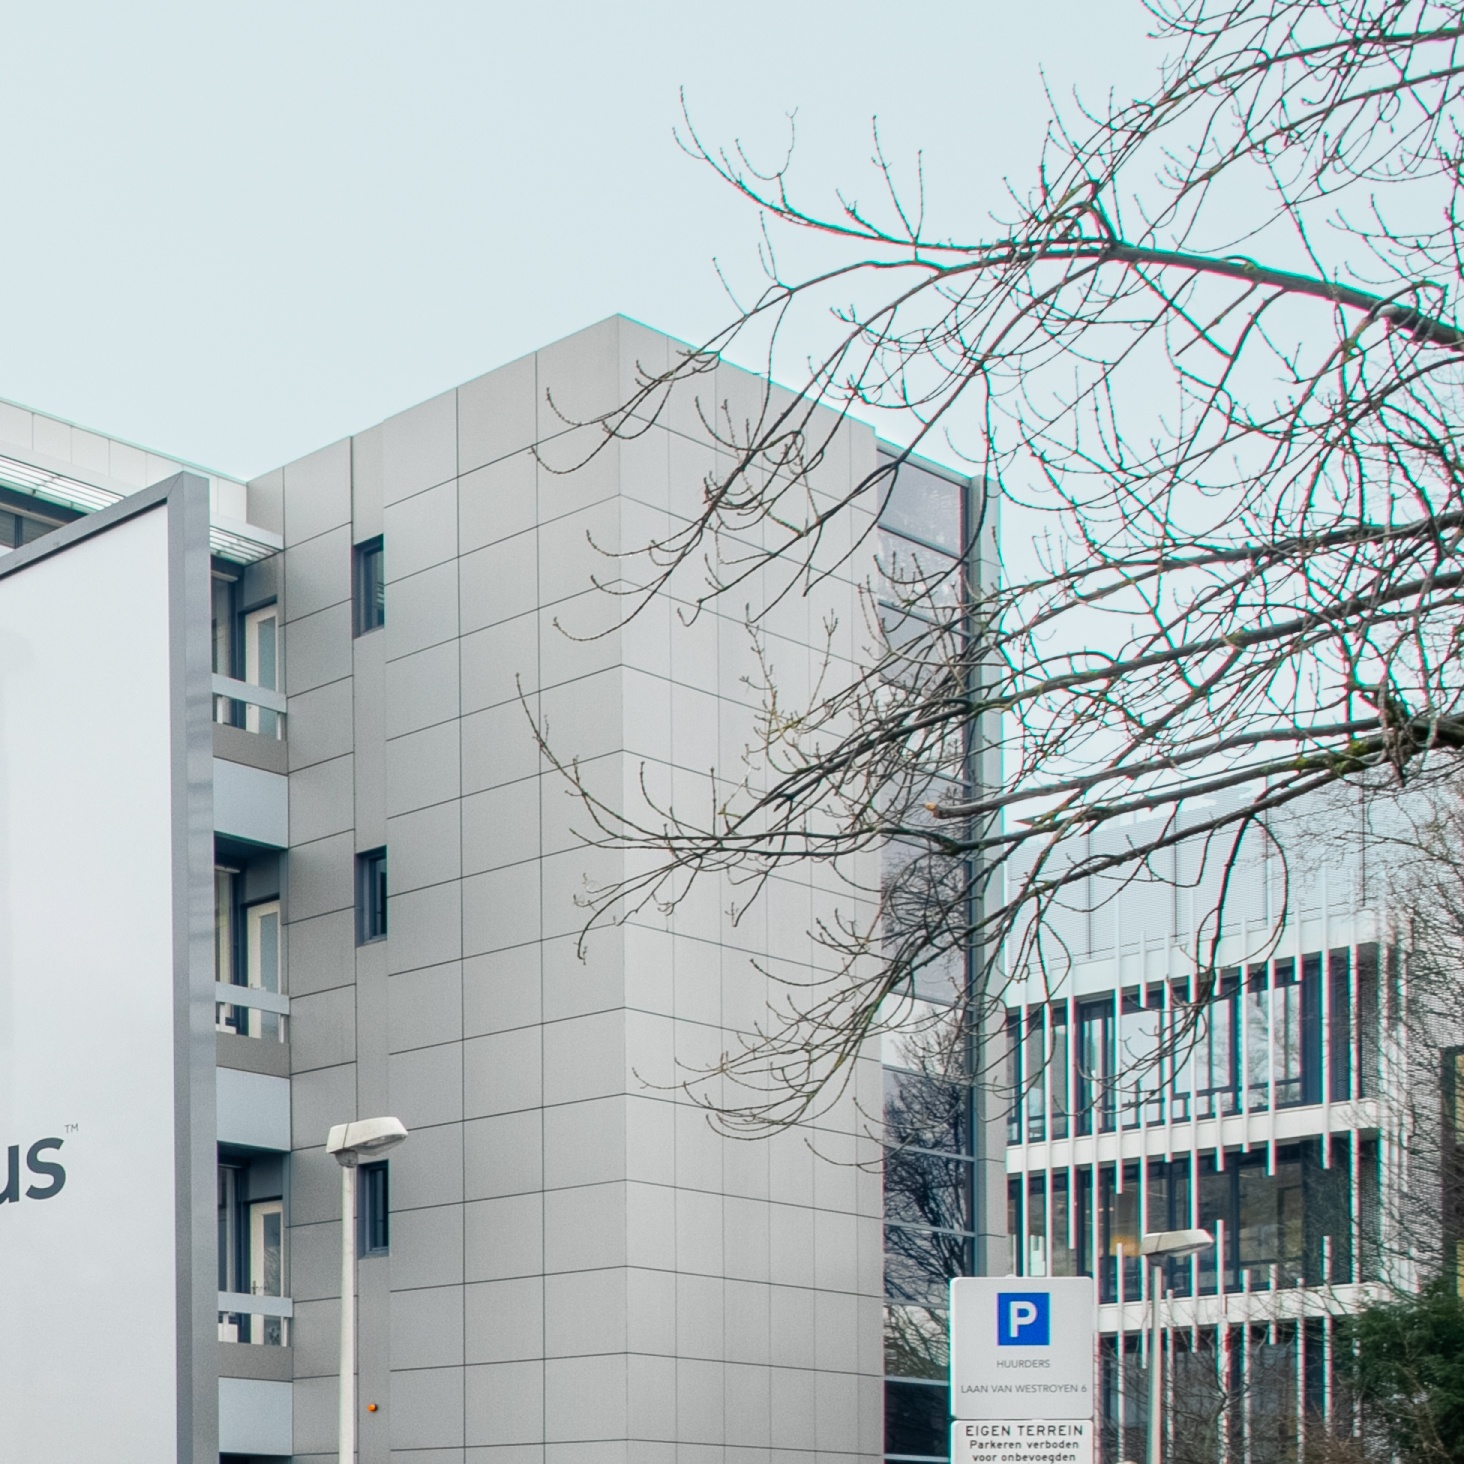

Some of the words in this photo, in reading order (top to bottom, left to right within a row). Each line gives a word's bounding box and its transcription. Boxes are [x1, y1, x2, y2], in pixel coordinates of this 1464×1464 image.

[1009, 1300, 1038, 1338] P
[996, 1359, 1051, 1369] HUURDERS
[960, 1385, 989, 1394] LAAN
[991, 1385, 1013, 1393] VAN
[1015, 1384, 1078, 1393] WESTROYEN
[1080, 1384, 1088, 1393] 6
[965, 1425, 1011, 1437] EIGEN
[1017, 1425, 1084, 1436] TERREIN
[969, 1440, 1022, 1450] Parkeren
[1026, 1439, 1080, 1449] verboden
[972, 1453, 998, 1462] voor
[1000, 1452, 1077, 1464] onbevoegden
